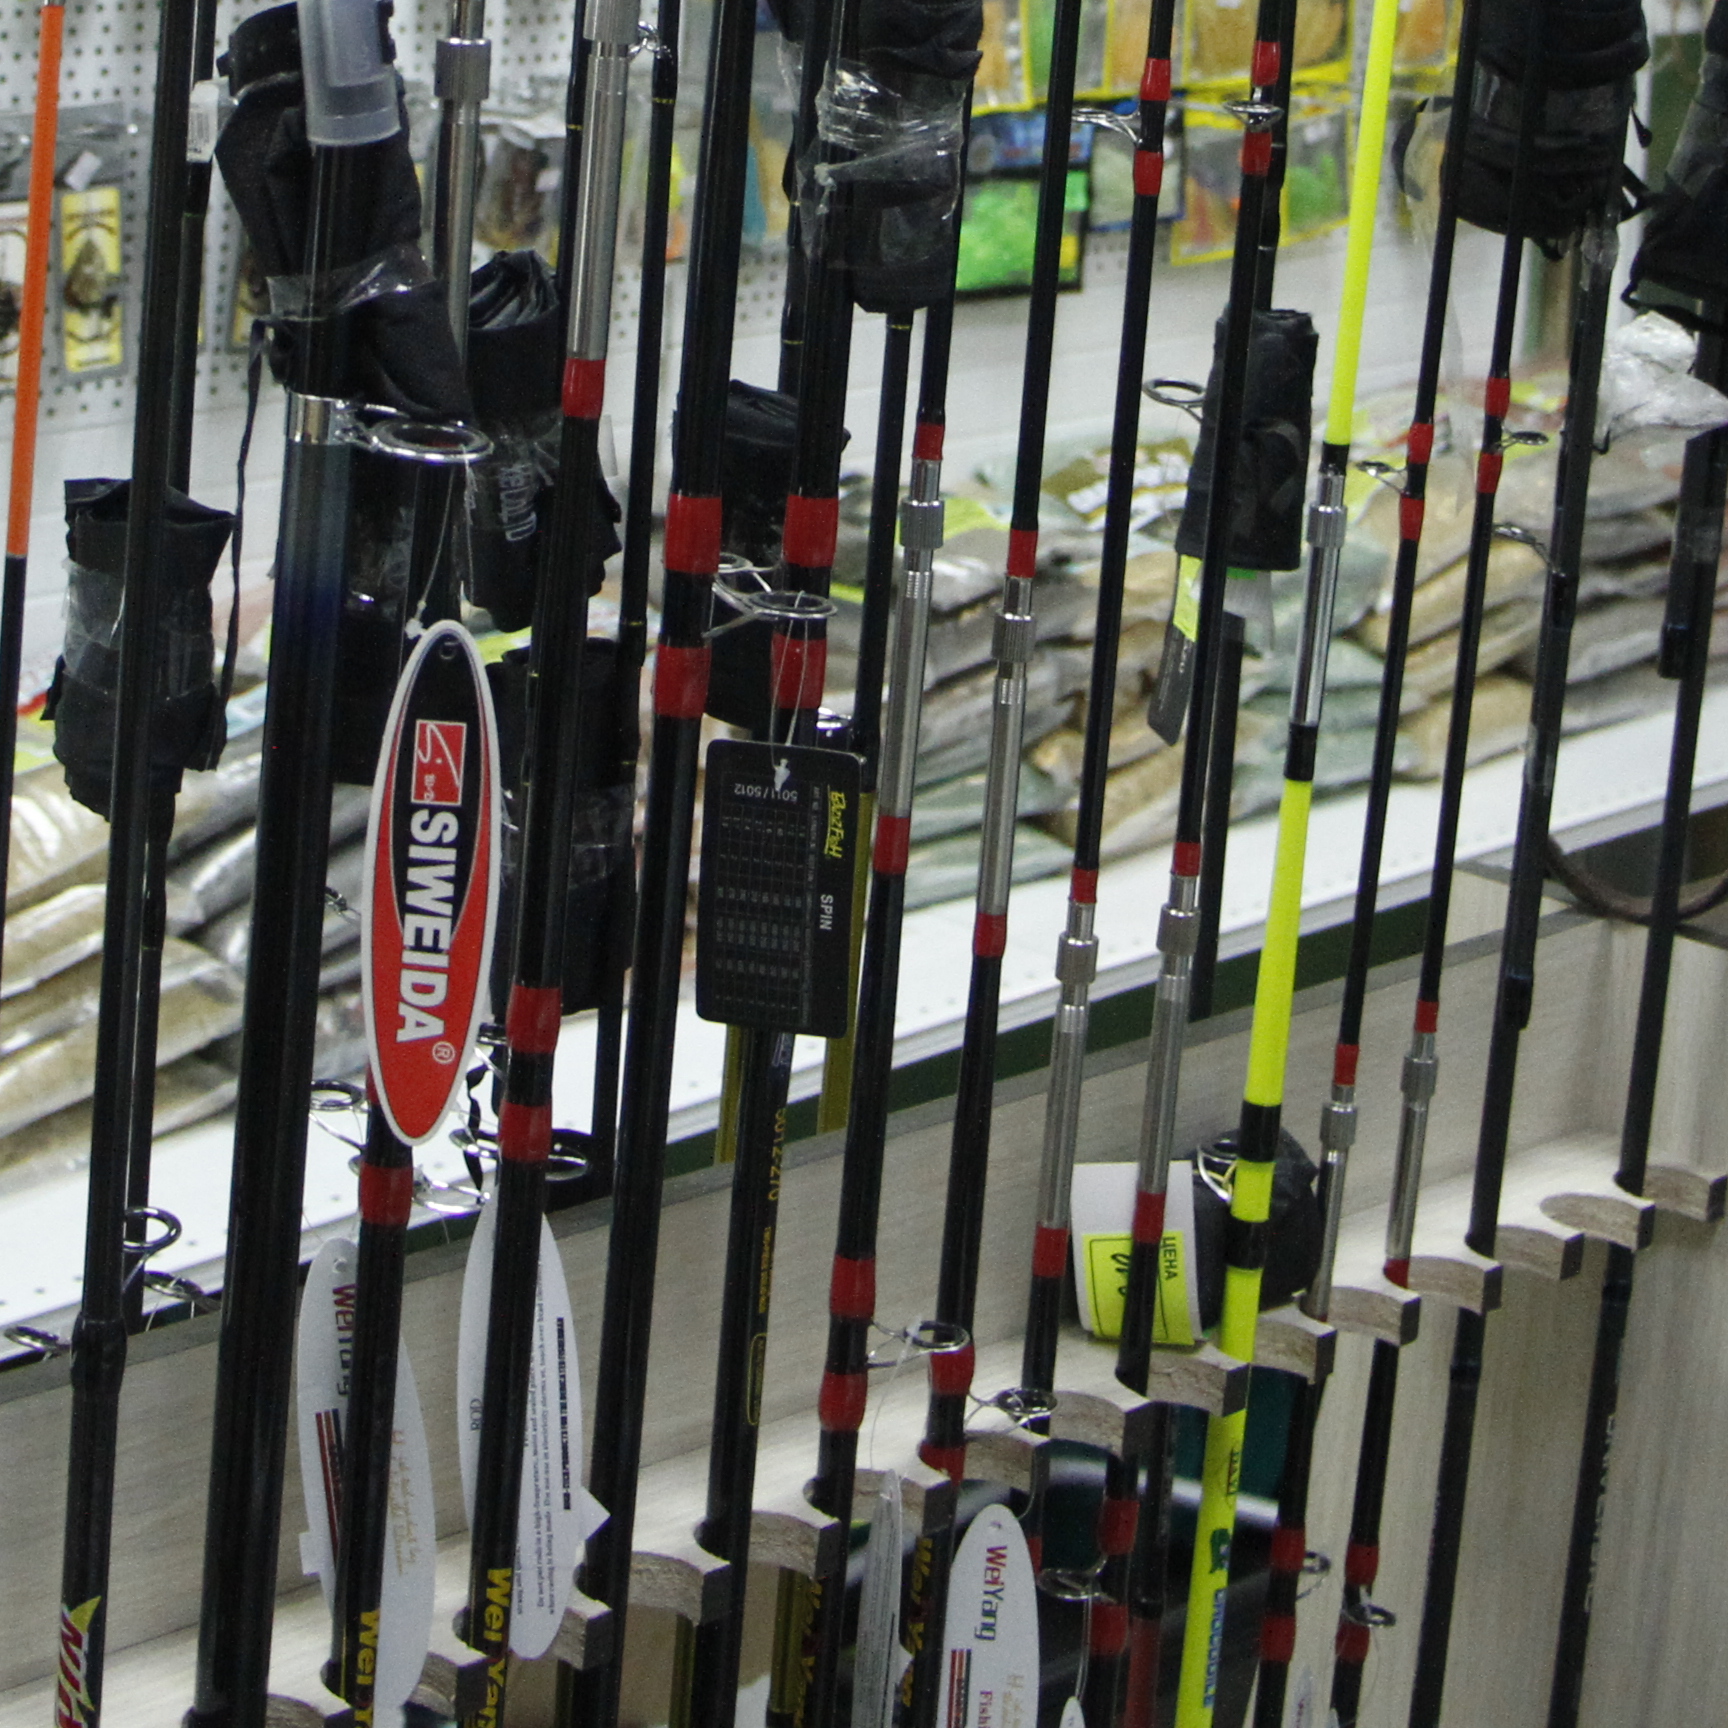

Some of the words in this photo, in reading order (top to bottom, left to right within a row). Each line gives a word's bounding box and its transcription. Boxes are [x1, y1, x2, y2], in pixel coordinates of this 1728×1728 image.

[396, 808, 459, 1043] SIWEIDA
[819, 893, 834, 931] SPIN
[1160, 1235, 1178, 1281] ЦЕНА
[471, 1398, 483, 1431] ROD
[974, 1544, 1008, 1643] WeiYang
[979, 1690, 993, 1728] Fishi
